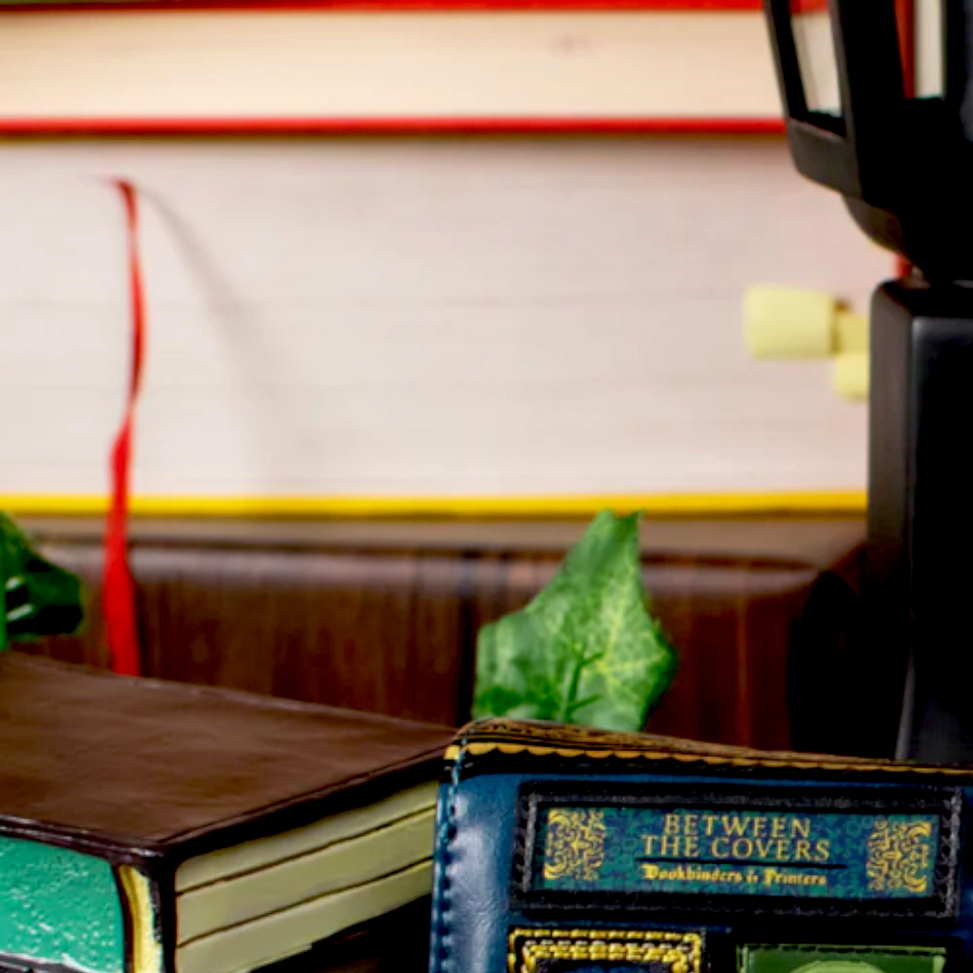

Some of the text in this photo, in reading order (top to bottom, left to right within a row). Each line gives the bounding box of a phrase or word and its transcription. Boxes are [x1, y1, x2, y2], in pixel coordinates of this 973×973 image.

[664, 813, 811, 838] BETWEEN
[641, 834, 831, 861] THE COVERS
[641, 863, 743, 884] Bookbinders
[763, 867, 827, 887] Printers
